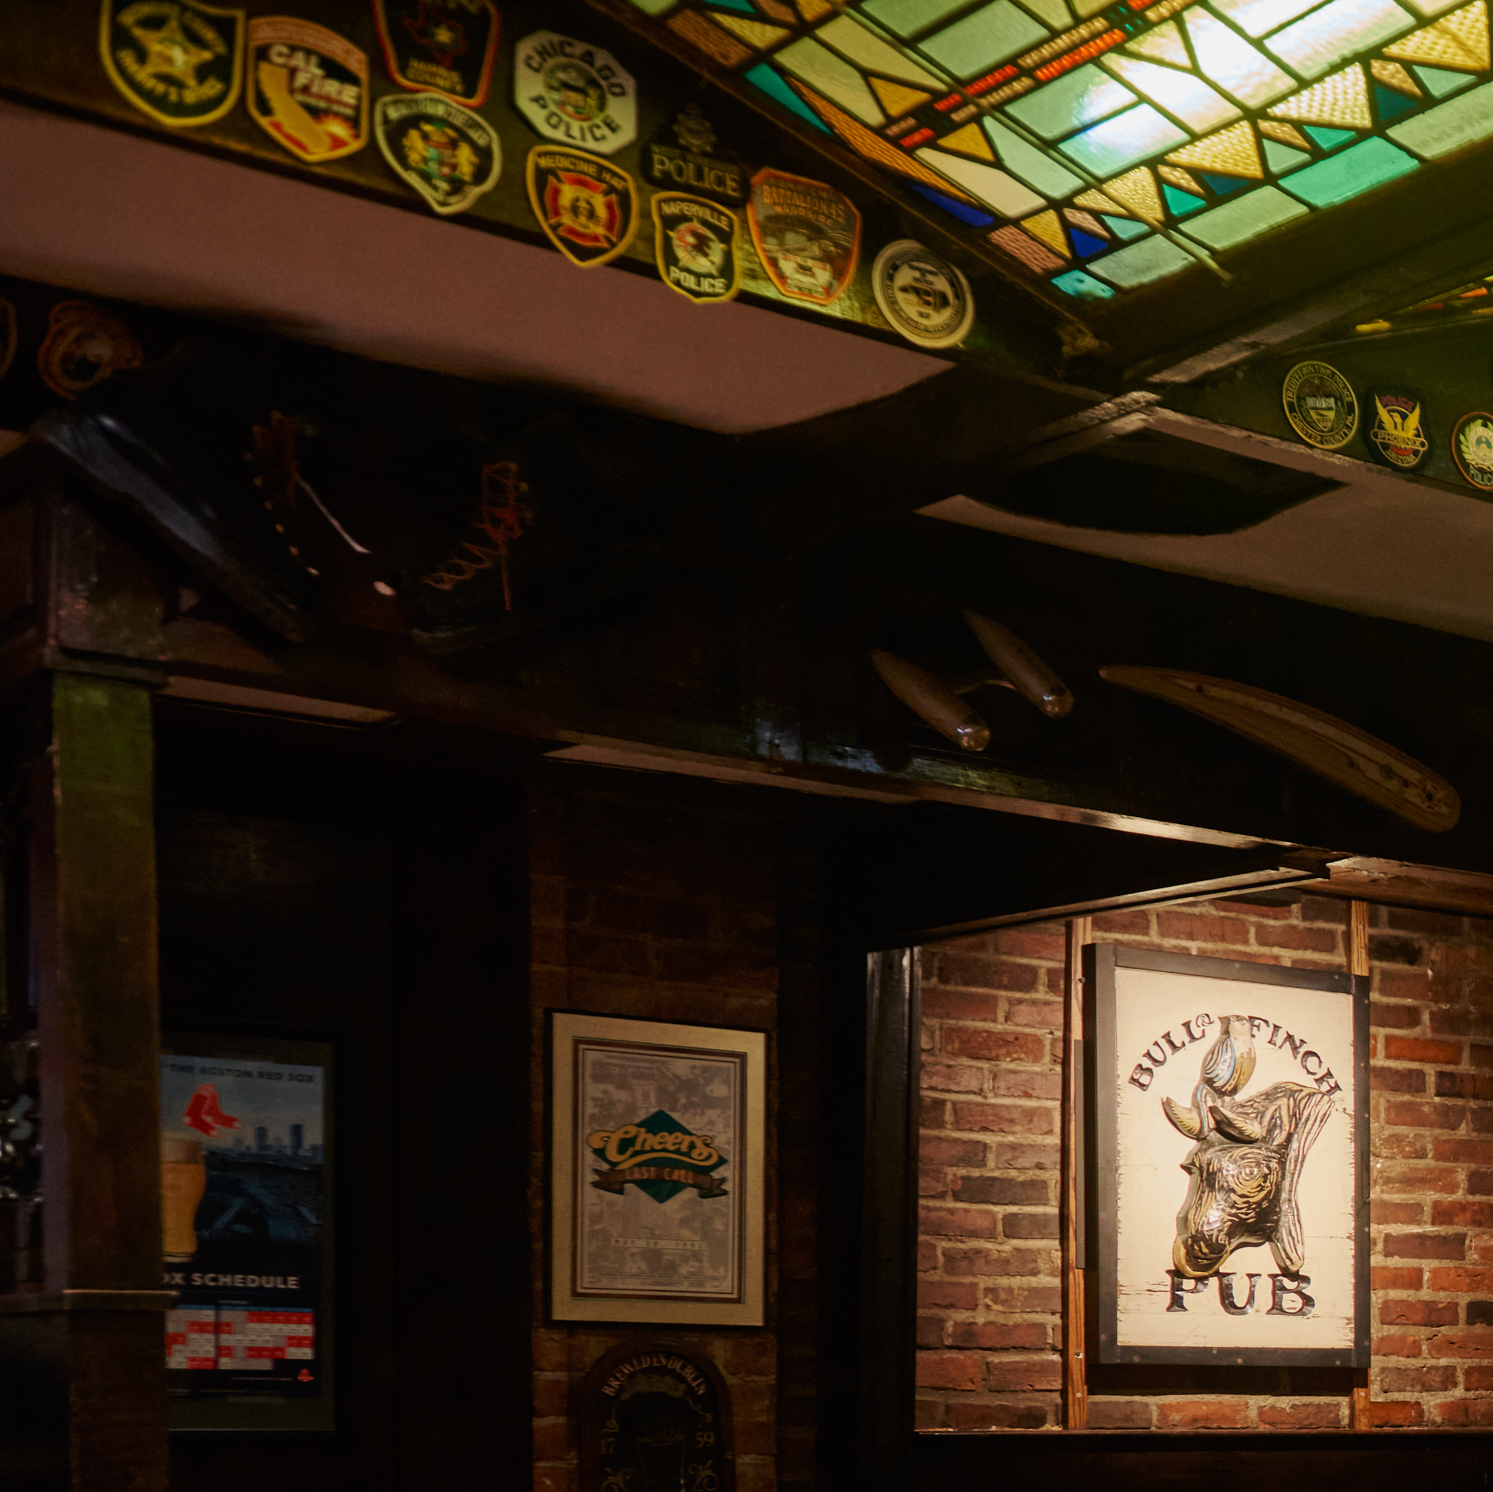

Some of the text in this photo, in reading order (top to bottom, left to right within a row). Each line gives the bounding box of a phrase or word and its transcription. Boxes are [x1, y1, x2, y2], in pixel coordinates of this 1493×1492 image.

[268, 44, 326, 77] CAL
[524, 37, 626, 98] CHICAGO
[292, 71, 360, 106] FIRE
[529, 95, 621, 143] POLICE
[536, 155, 627, 192] MEDICINE HAT
[651, 155, 741, 199] POLICE
[661, 202, 730, 231] NAPERVILLE
[762, 185, 831, 217] BATTALION
[669, 265, 728, 294] POLICE
[1333, 374, 1353, 402] POLICE
[1290, 412, 1321, 443] CHESTER
[1377, 429, 1421, 449] PHOENIX
[1127, 1018, 1206, 1093] BULL
[1247, 1015, 1344, 1097] FINCH
[170, 1063, 315, 1083] THE BOSTON RED SOX
[587, 1123, 720, 1170] Cheers
[625, 1168, 695, 1184] LAST CALL
[190, 1273, 301, 1289] SCHEDULE
[1165, 1268, 1316, 1317] PUB
[600, 1352, 708, 1397] BREWED IN DUBLIN
[600, 1437, 617, 1455] 17
[695, 1431, 715, 1449] 59
